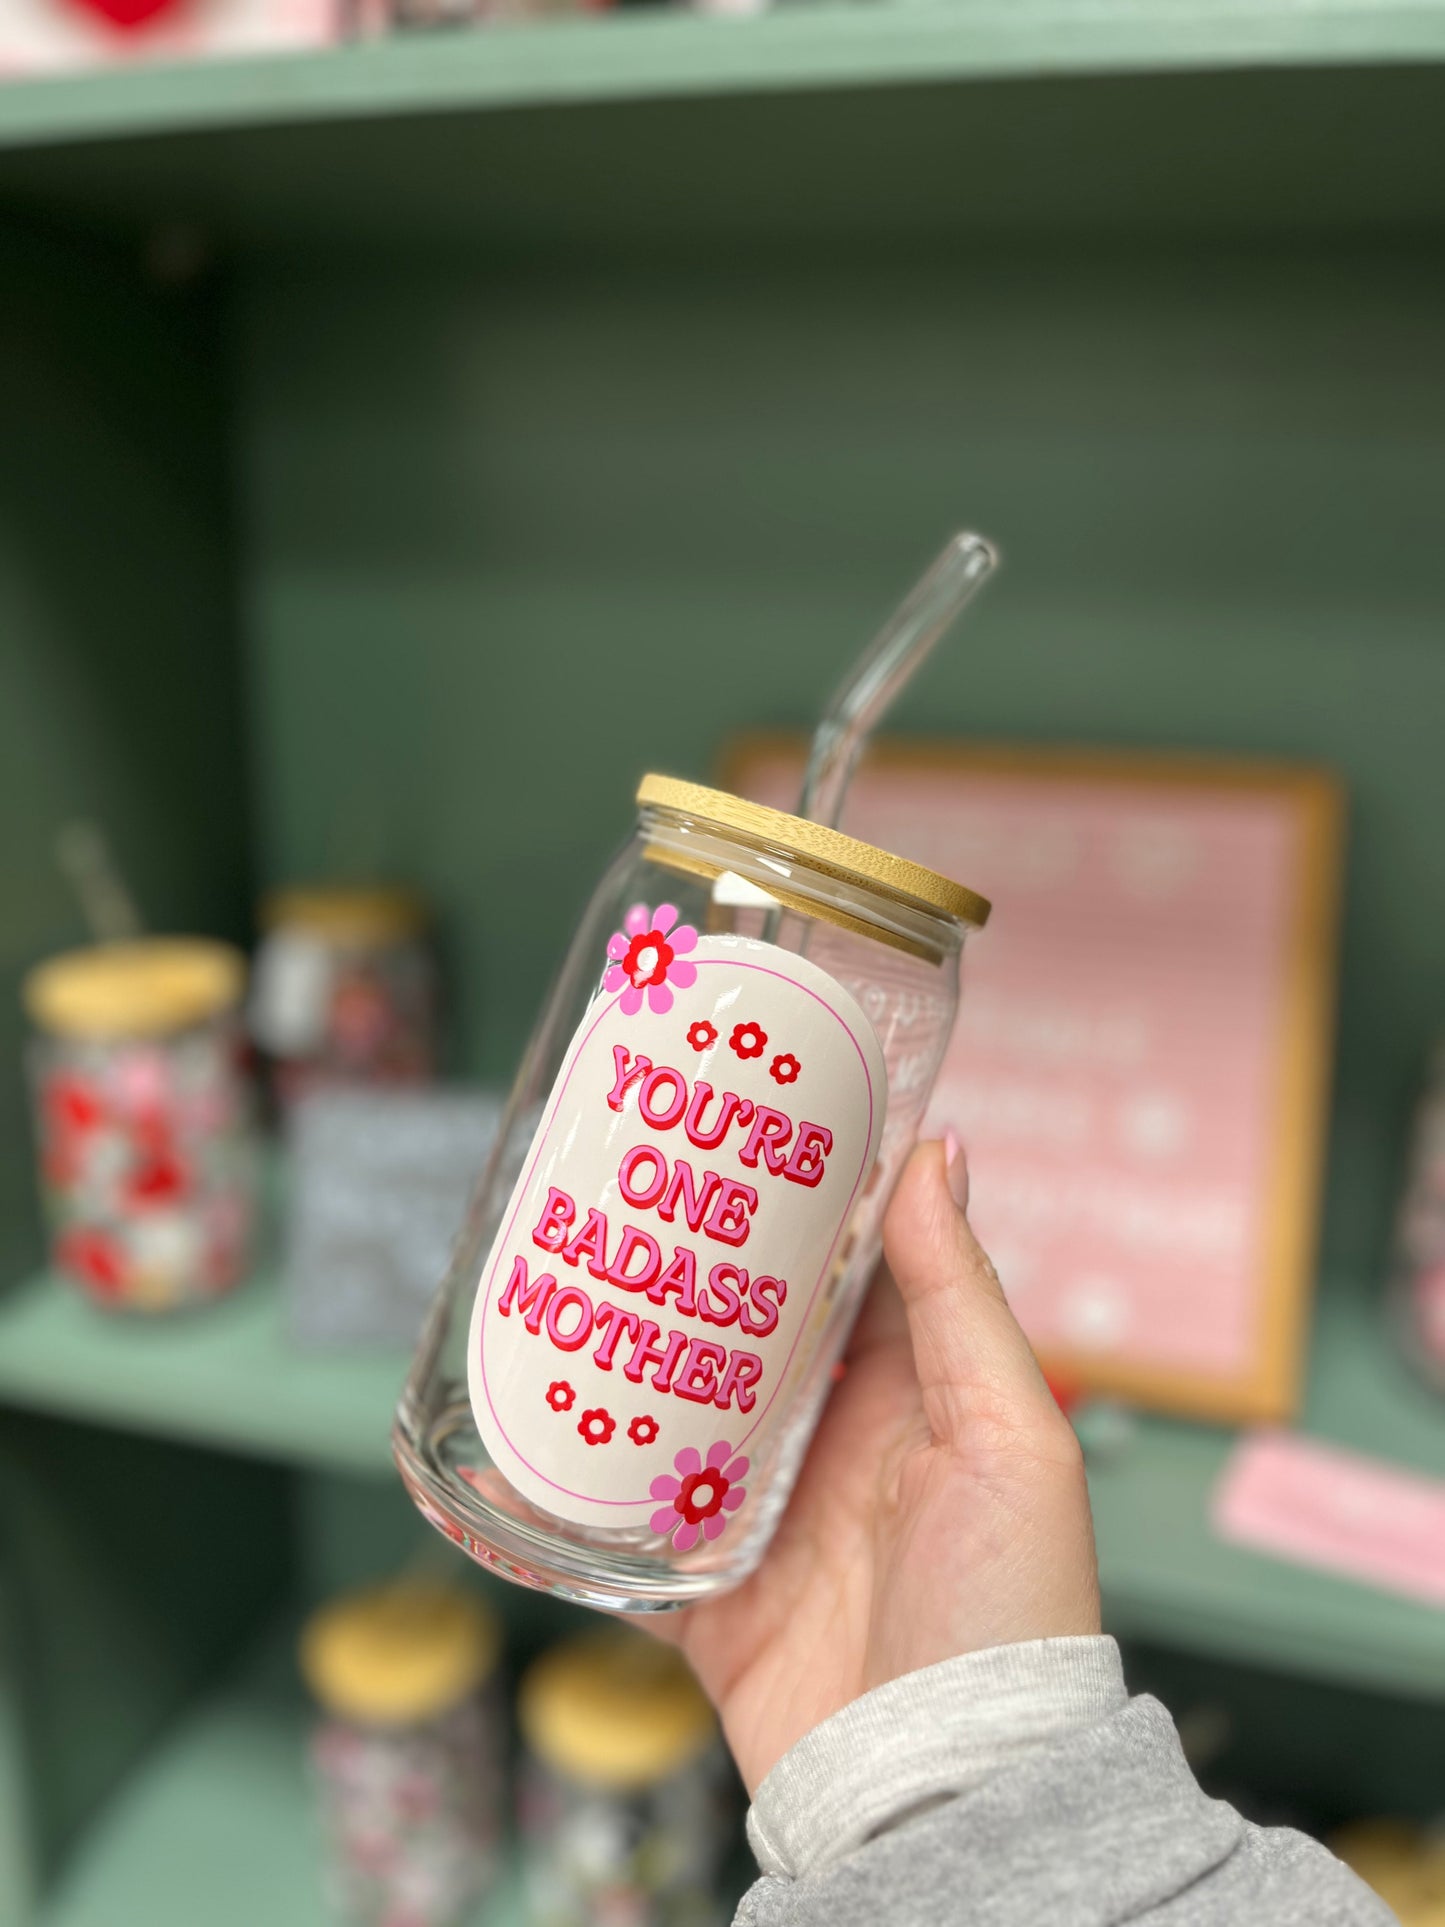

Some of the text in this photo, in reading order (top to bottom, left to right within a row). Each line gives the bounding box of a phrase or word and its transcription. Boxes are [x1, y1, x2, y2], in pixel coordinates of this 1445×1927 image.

[607, 1045, 832, 1187] YOU'RE
[532, 1186, 787, 1338] BADASS
[618, 1145, 758, 1247] ONE
[498, 1255, 763, 1414] MOTHER
